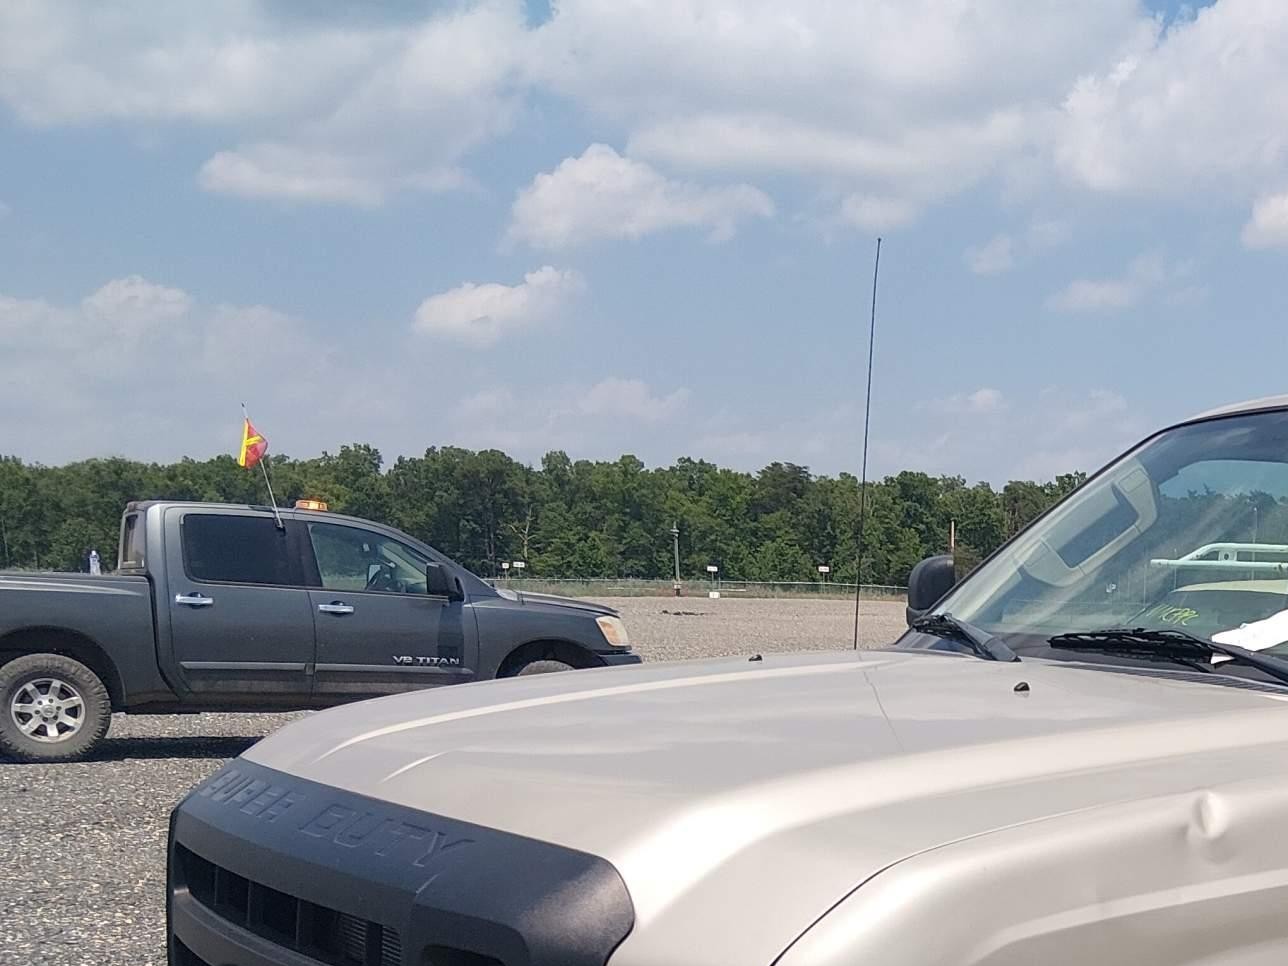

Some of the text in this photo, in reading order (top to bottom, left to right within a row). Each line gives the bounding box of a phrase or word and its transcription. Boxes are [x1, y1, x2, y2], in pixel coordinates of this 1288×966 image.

[392, 655, 460, 665] V8 TITAN
[200, 770, 476, 867] SUPER DUTY
